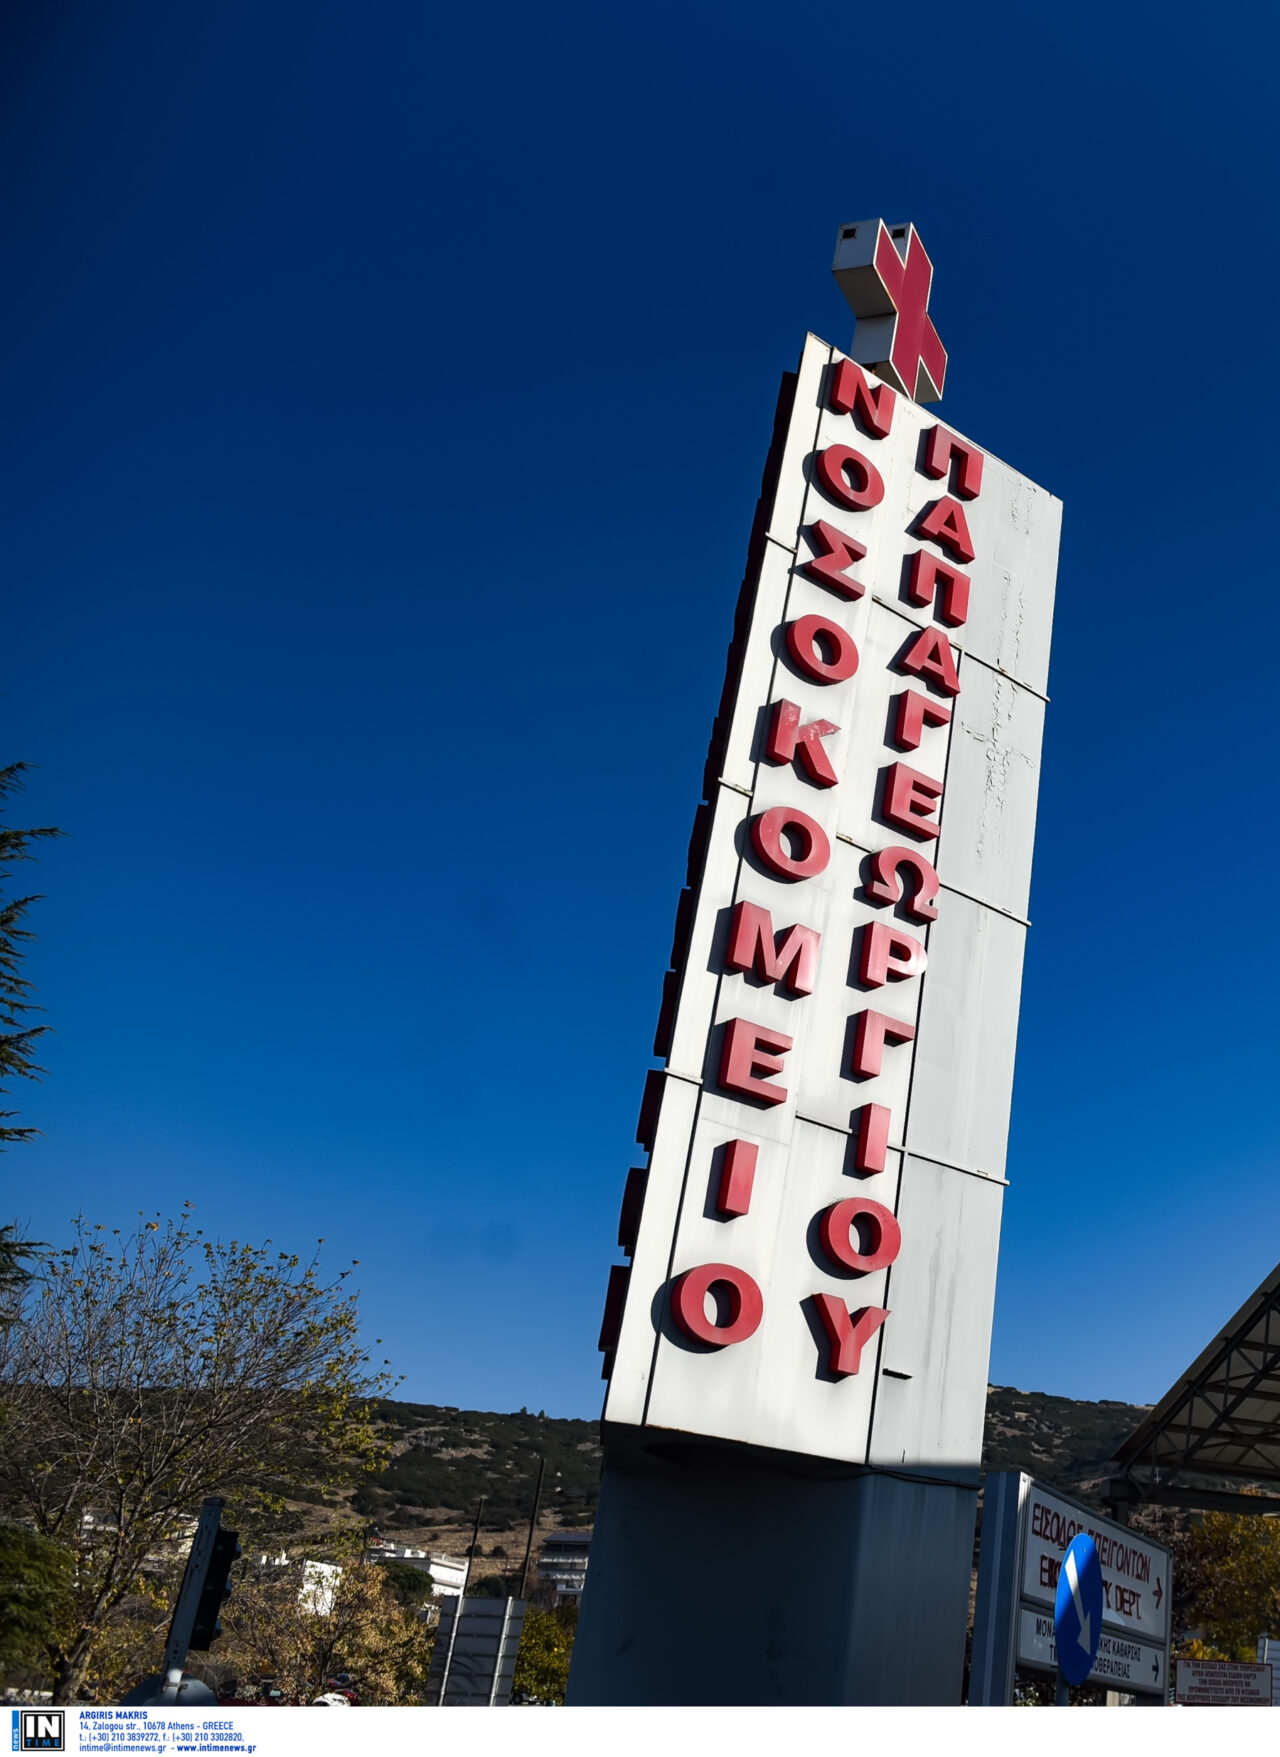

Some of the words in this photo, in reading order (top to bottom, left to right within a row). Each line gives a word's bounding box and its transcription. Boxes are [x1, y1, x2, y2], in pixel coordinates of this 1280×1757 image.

[671, 358, 896, 1347] ΝΟΣΟΚΟΜΕΙΟ
[813, 424, 983, 1376] ΠΑΠΑΓΕΩΡΓΙΟΥ
[1088, 1528, 1151, 1584] ΠΕΙΓΟΝΤΩΝ
